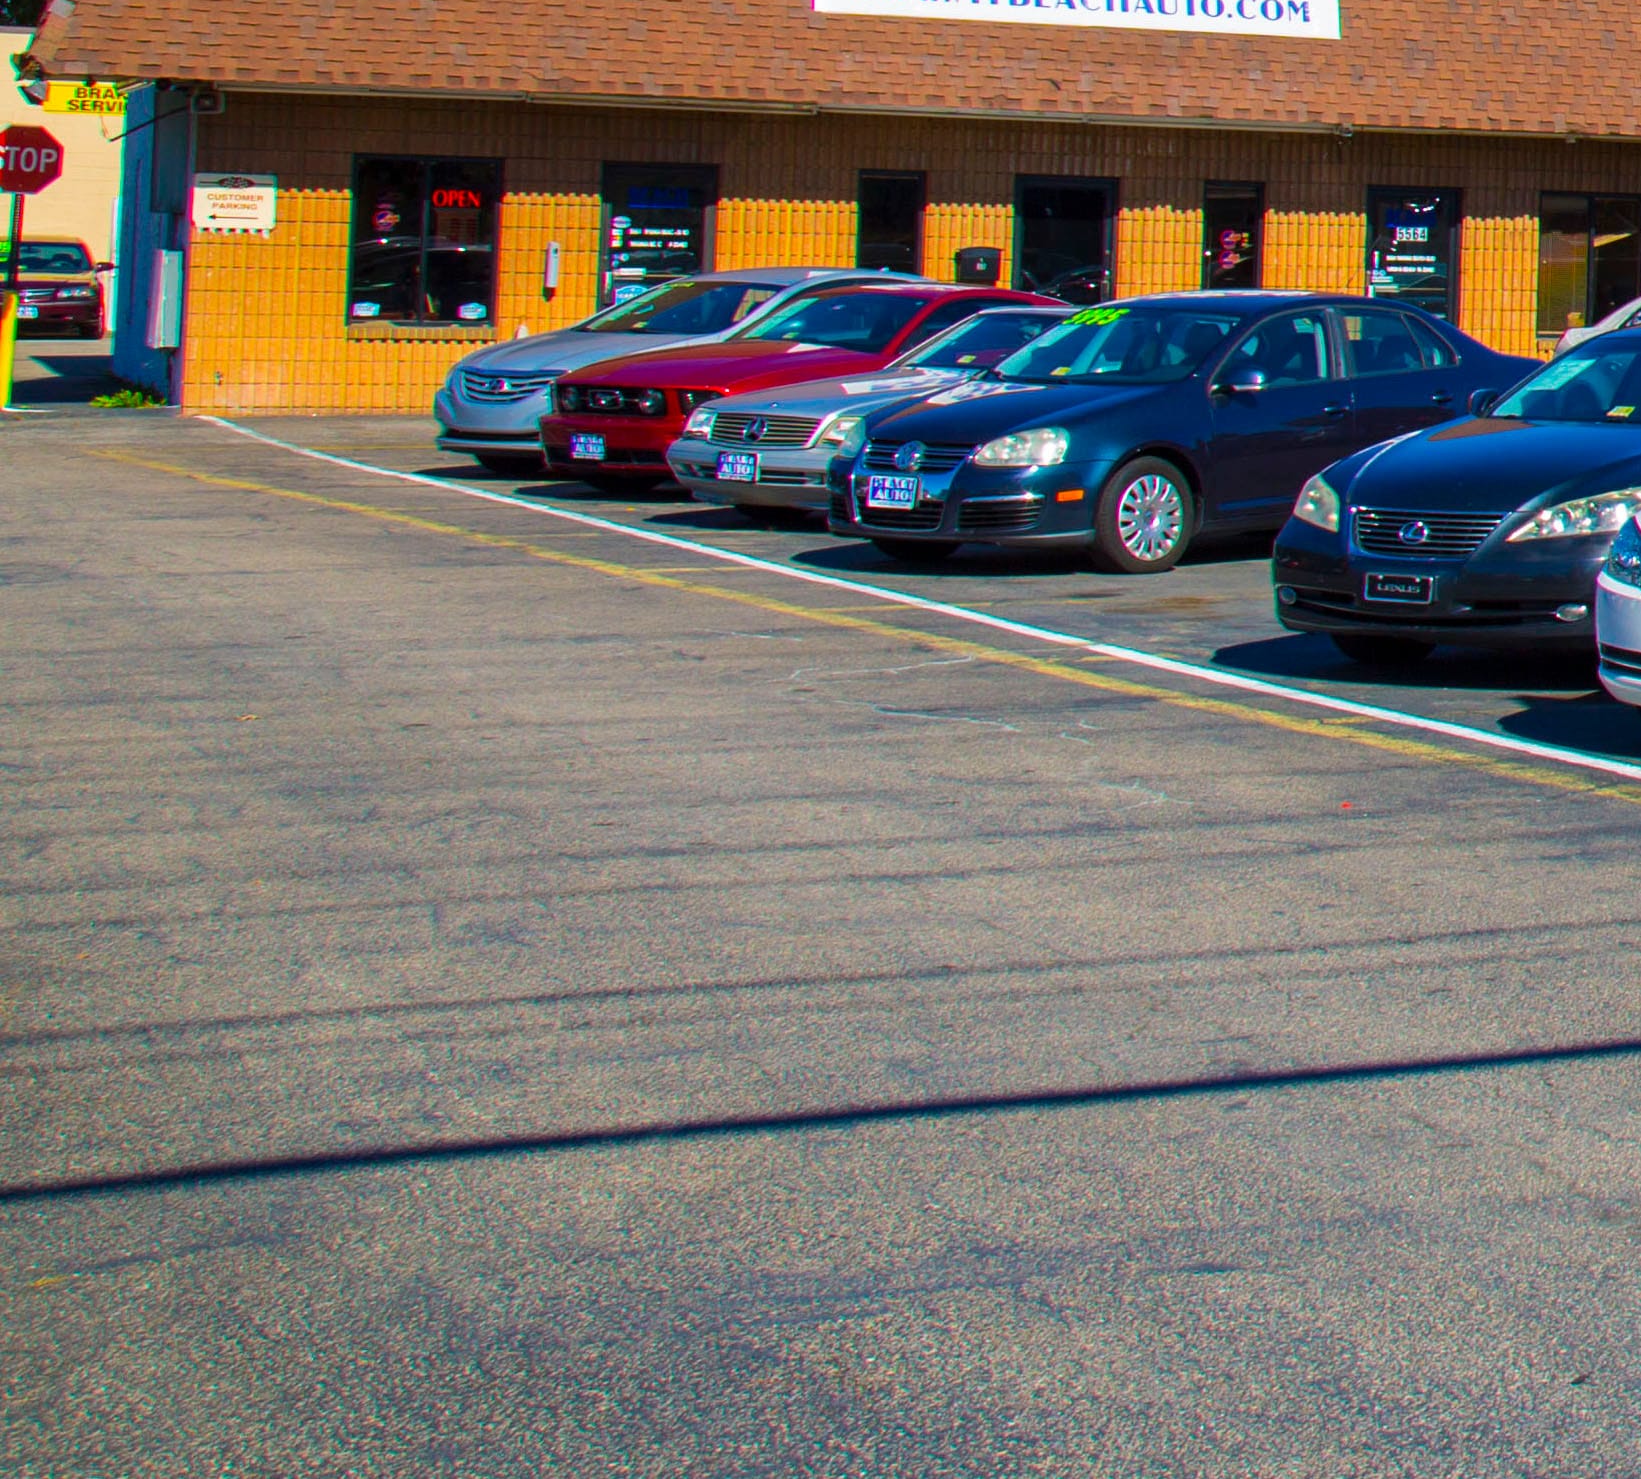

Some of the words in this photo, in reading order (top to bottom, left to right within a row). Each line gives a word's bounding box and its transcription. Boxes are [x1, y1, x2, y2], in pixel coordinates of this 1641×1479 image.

[68, 99, 128, 111] SERVI
[207, 192, 264, 202] CUSTOMER
[432, 189, 481, 208] OPEN
[212, 202, 258, 210] PARKING
[1398, 227, 1426, 240] 5564
[874, 488, 909, 500] AUTO
